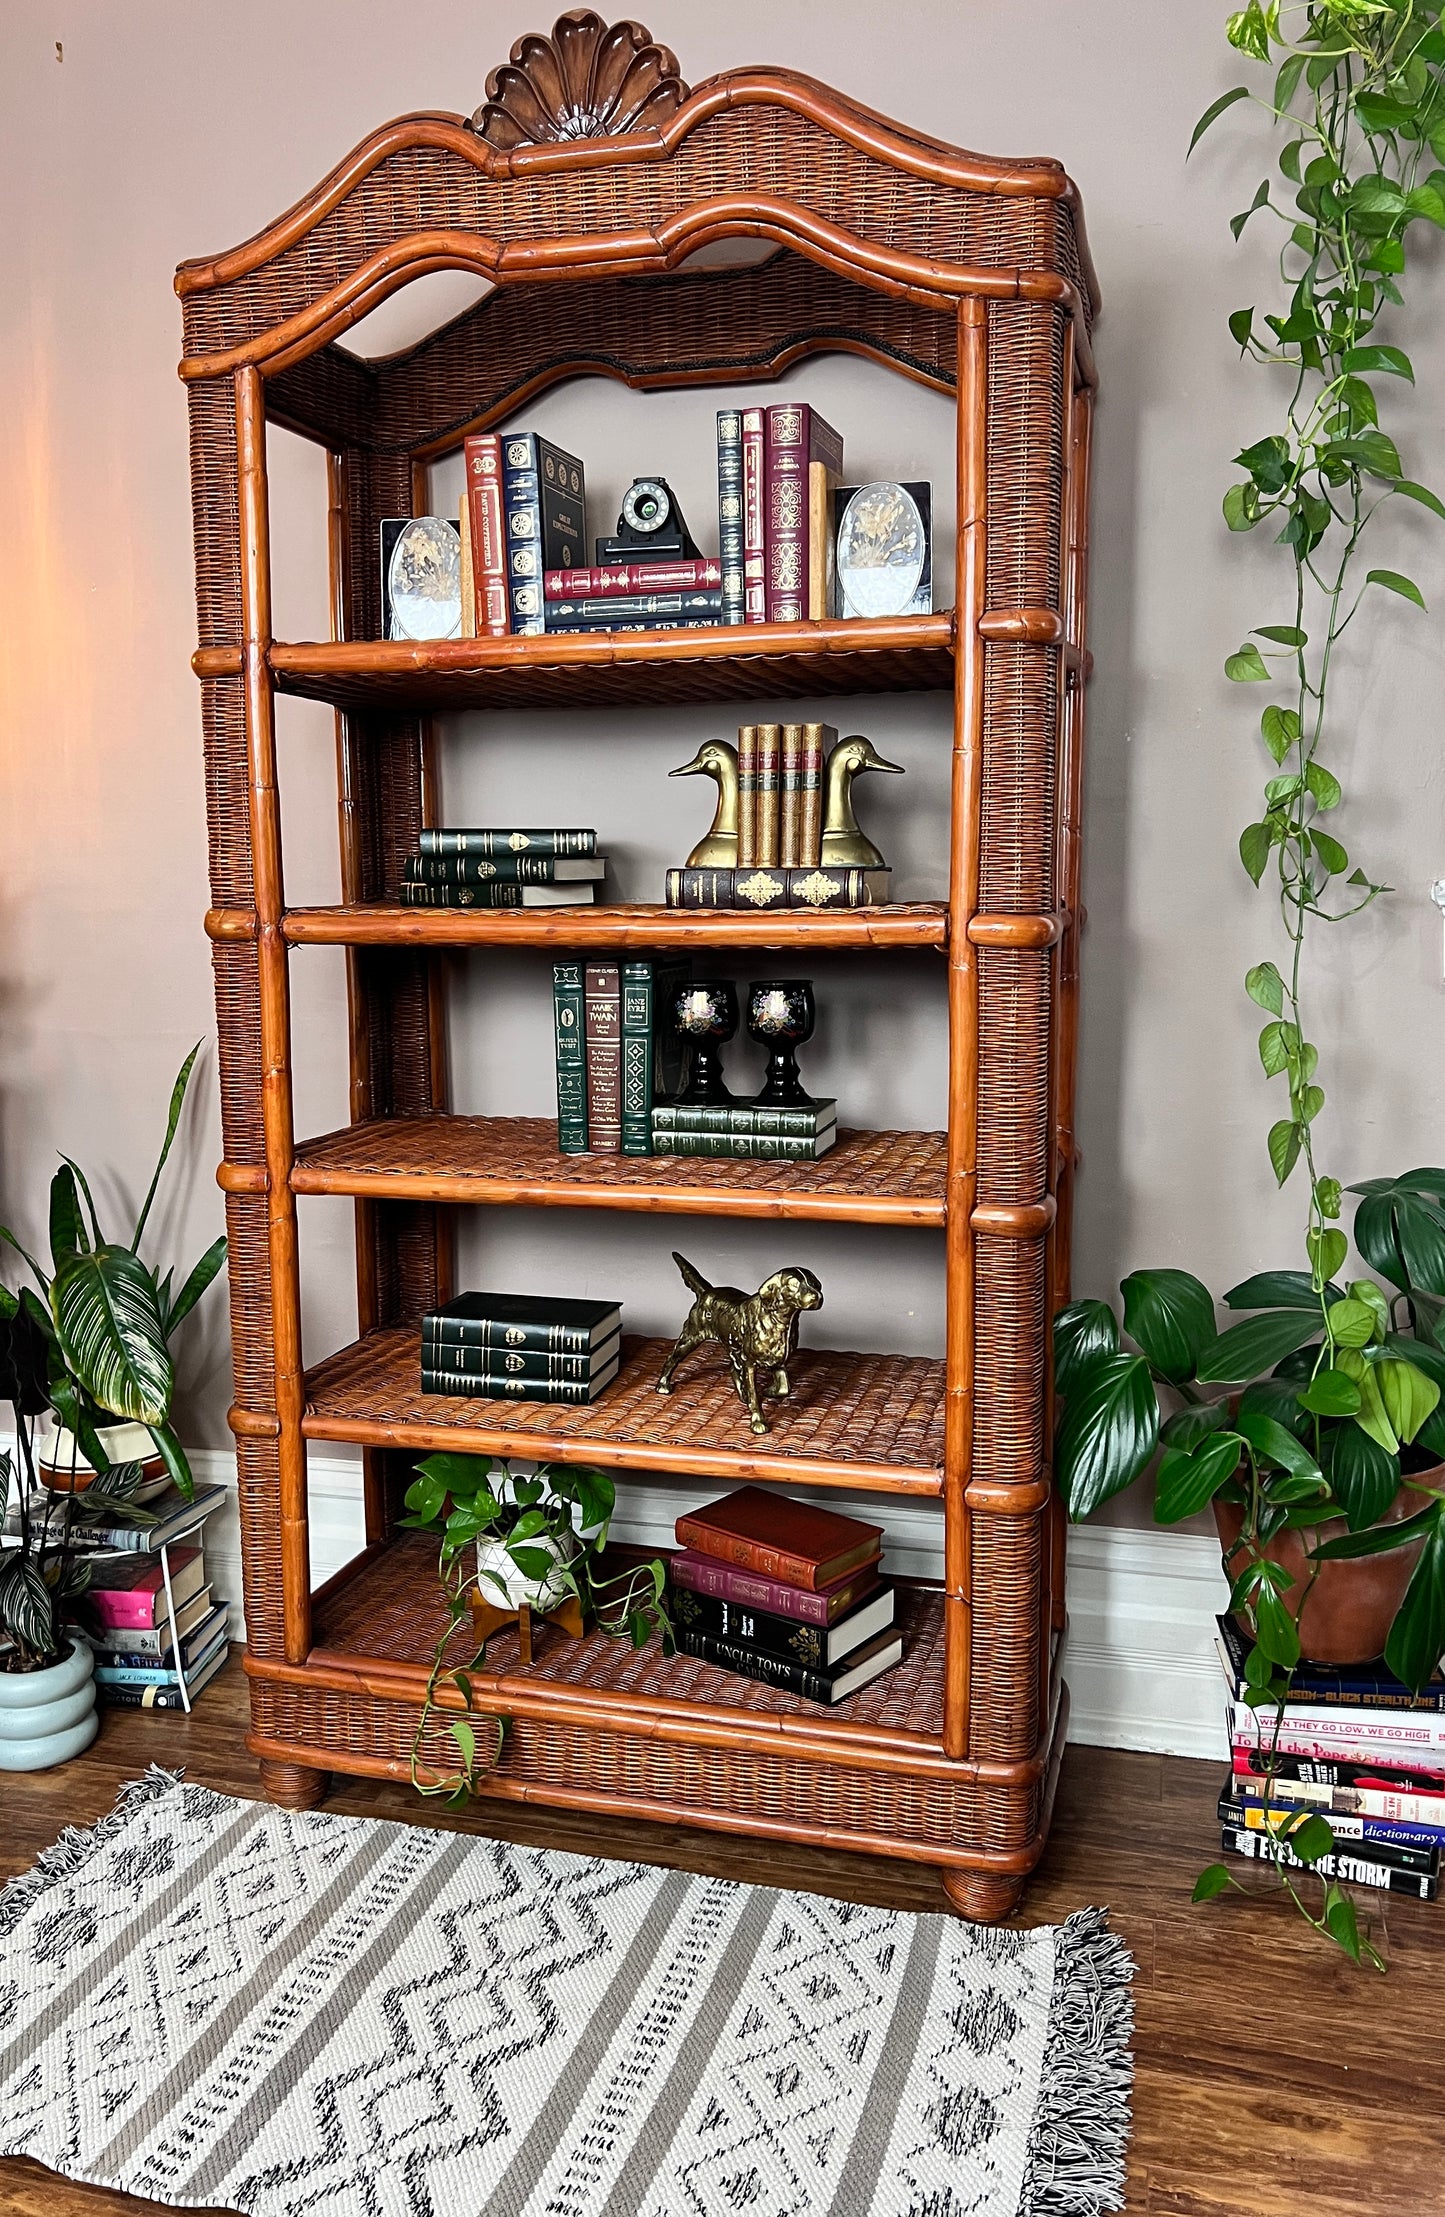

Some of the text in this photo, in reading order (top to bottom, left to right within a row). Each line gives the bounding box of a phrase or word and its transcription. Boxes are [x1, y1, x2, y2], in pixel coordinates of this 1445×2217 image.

[480, 492, 492, 567] DAVID COPPERFIELD
[591, 1004, 614, 1012] MARK
[627, 998, 646, 1006] JANE
[589, 1012, 617, 1022] TWAIN
[75, 1527, 110, 1544] Challenger
[716, 1643, 791, 1678] UNCLE TOM'S
[736, 1662, 770, 1682] CABIN
[1325, 1691, 1362, 1703] BLACK
[1362, 1693, 1412, 1706] STEALTH
[1259, 1718, 1290, 1728] WHN
[1293, 1721, 1320, 1730] THEY
[1322, 1723, 1337, 1731] GO
[1367, 1728, 1384, 1736] WE
[1387, 1729, 1402, 1737] GO
[1405, 1731, 1430, 1740] HIGH
[1234, 1733, 1252, 1746] To
[1287, 1742, 1310, 1754] the
[1313, 1742, 1348, 1761] Pope
[1371, 1756, 1393, 1766] Tad
[1227, 1810, 1243, 1822] JANET
[1309, 1854, 1336, 1875] HE
[1337, 1856, 1392, 1890] STORM
